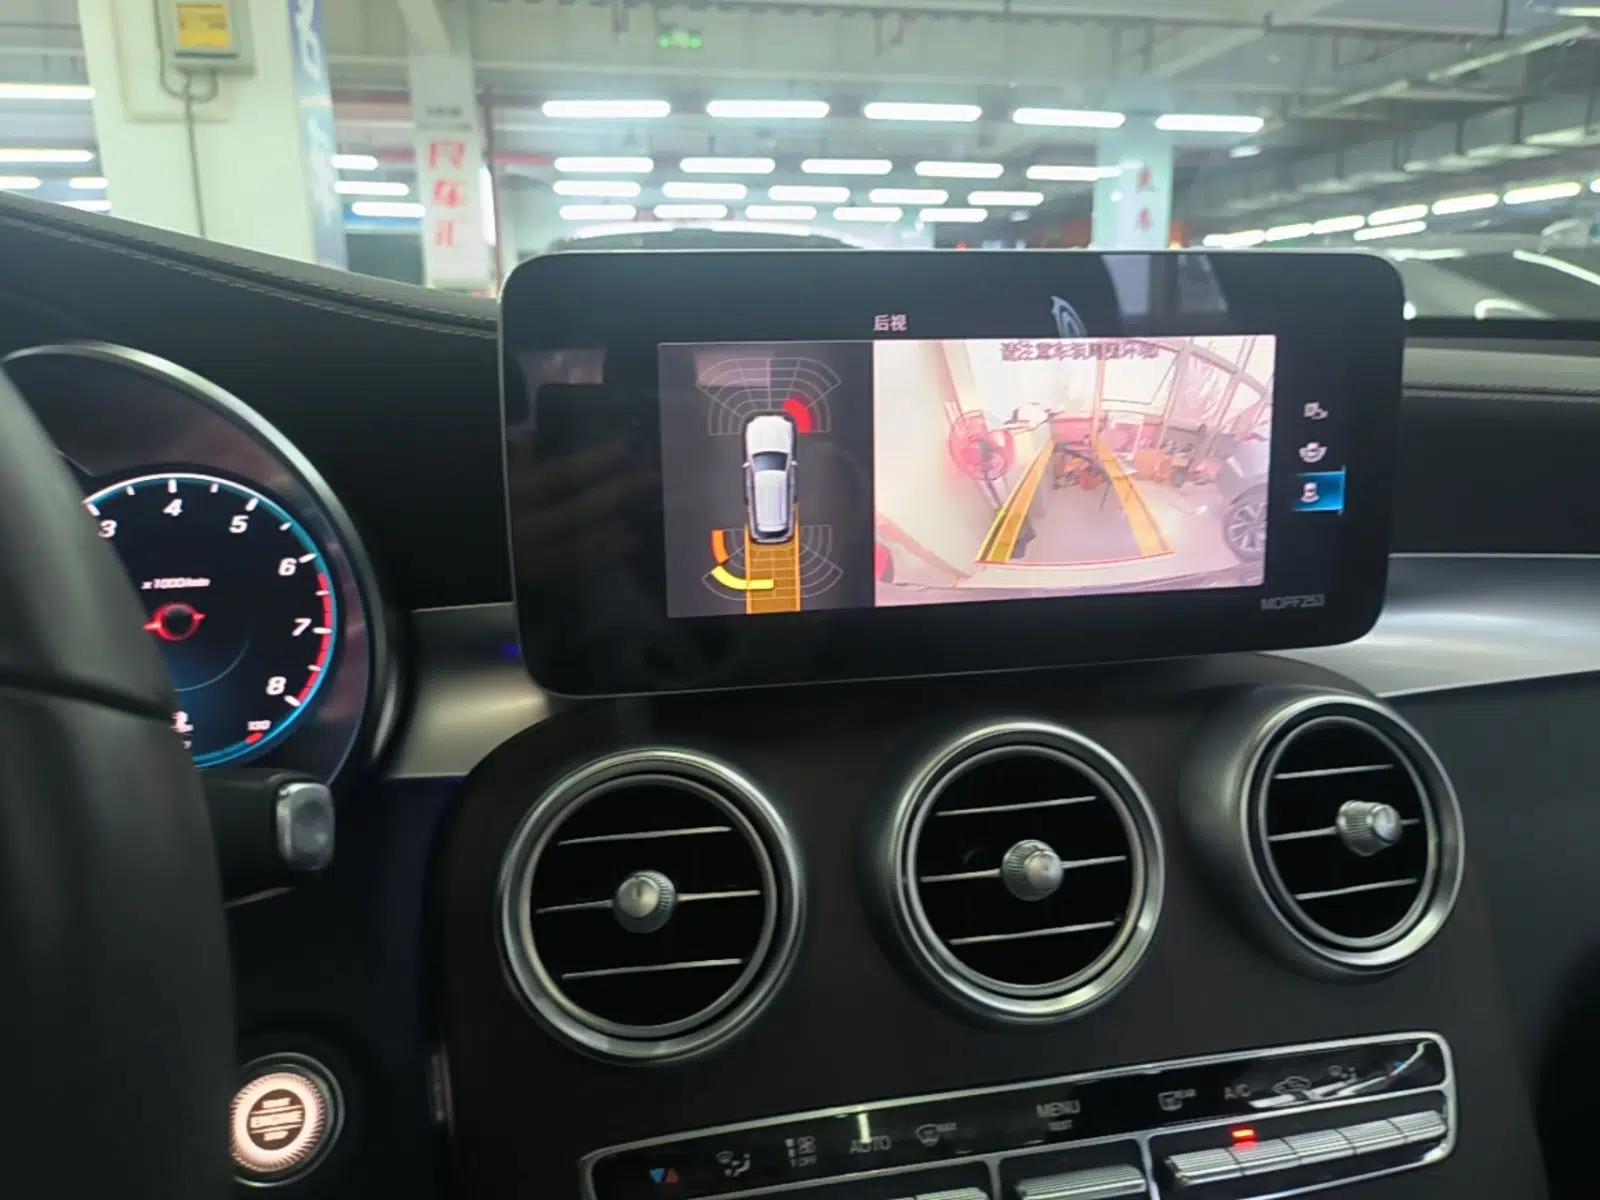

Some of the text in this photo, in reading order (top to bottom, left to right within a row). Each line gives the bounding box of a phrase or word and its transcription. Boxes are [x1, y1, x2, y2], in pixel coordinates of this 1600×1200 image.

[873, 314, 908, 331] 后视
[163, 499, 183, 517] 4
[99, 520, 117, 538] 3
[229, 515, 249, 533] 5
[278, 557, 297, 576] 6
[292, 618, 312, 636] 7
[266, 676, 287, 695] 8
[1036, 1100, 1080, 1118] MENU
[850, 1136, 892, 1154] AUTO
